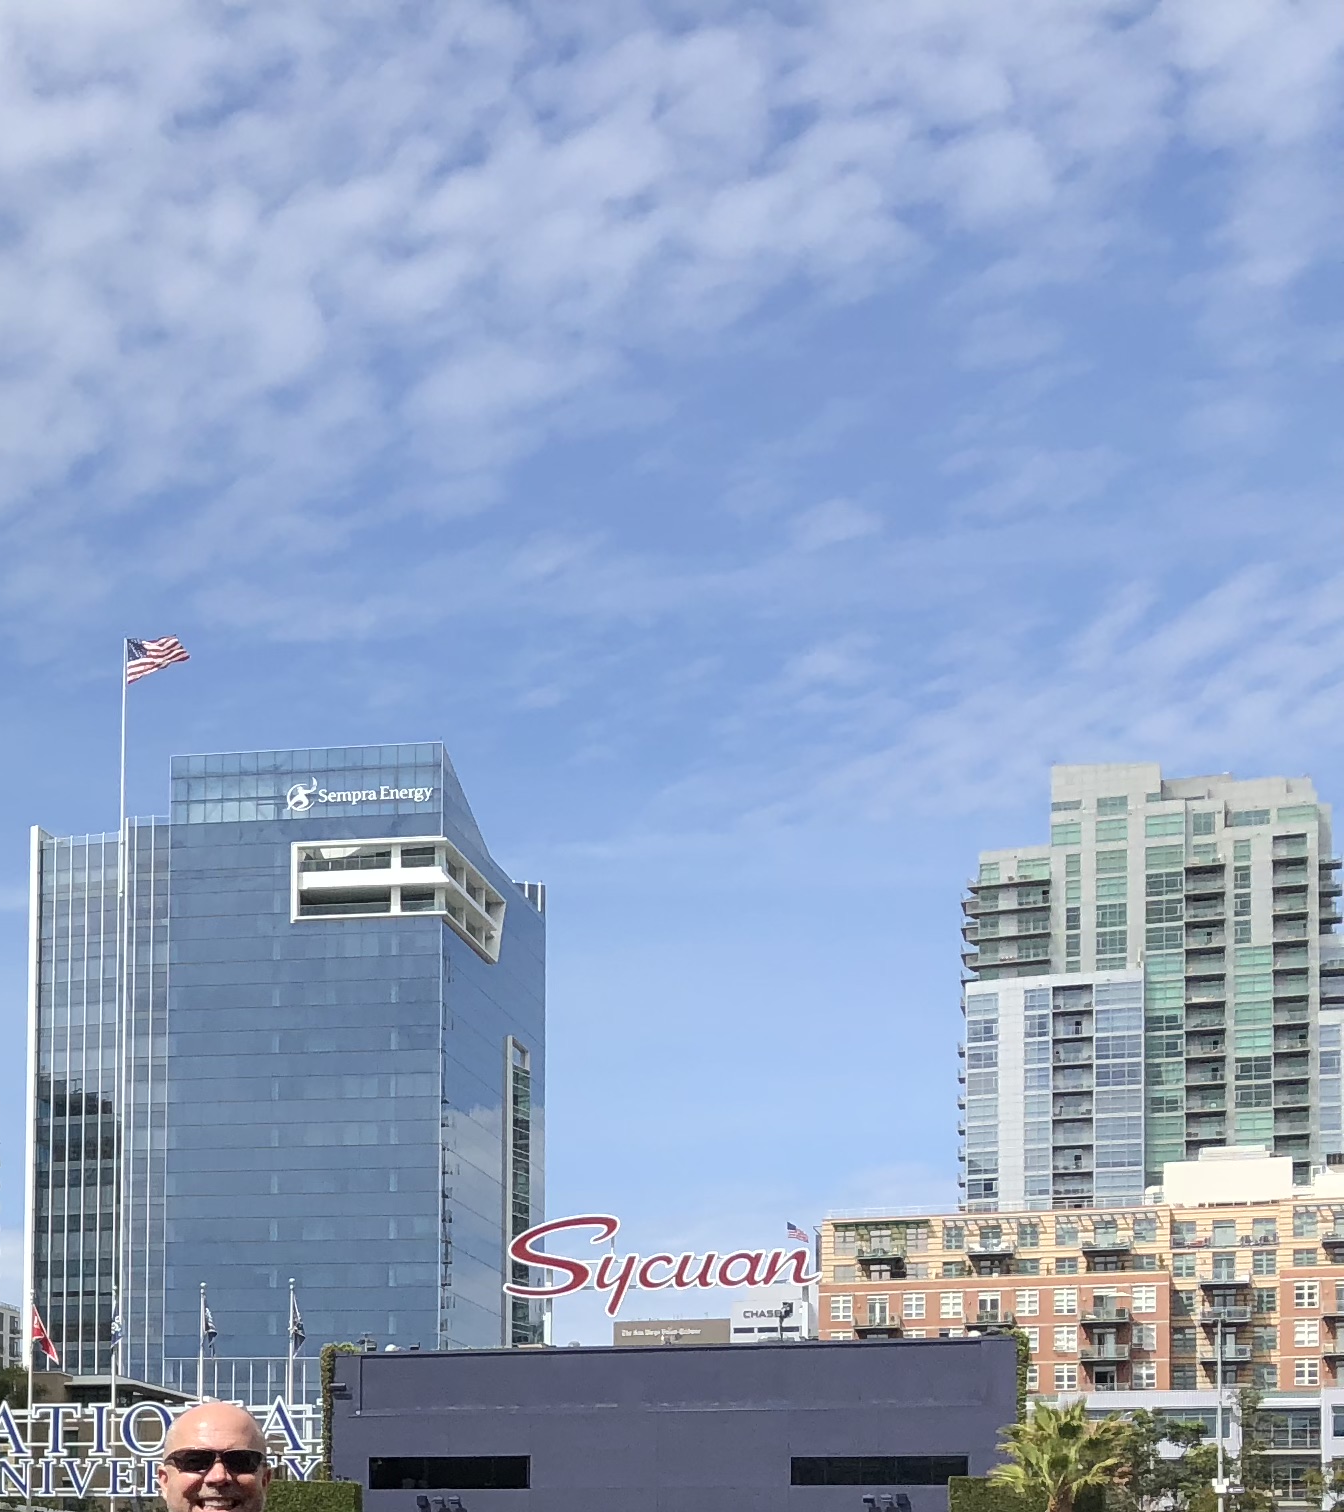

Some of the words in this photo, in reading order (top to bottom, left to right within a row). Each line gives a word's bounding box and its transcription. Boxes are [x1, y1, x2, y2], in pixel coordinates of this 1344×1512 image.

[318, 788, 376, 805] Sempra
[379, 785, 433, 802] Energy
[503, 1213, 824, 1317] Sycuan
[742, 1309, 783, 1319] CHASE
